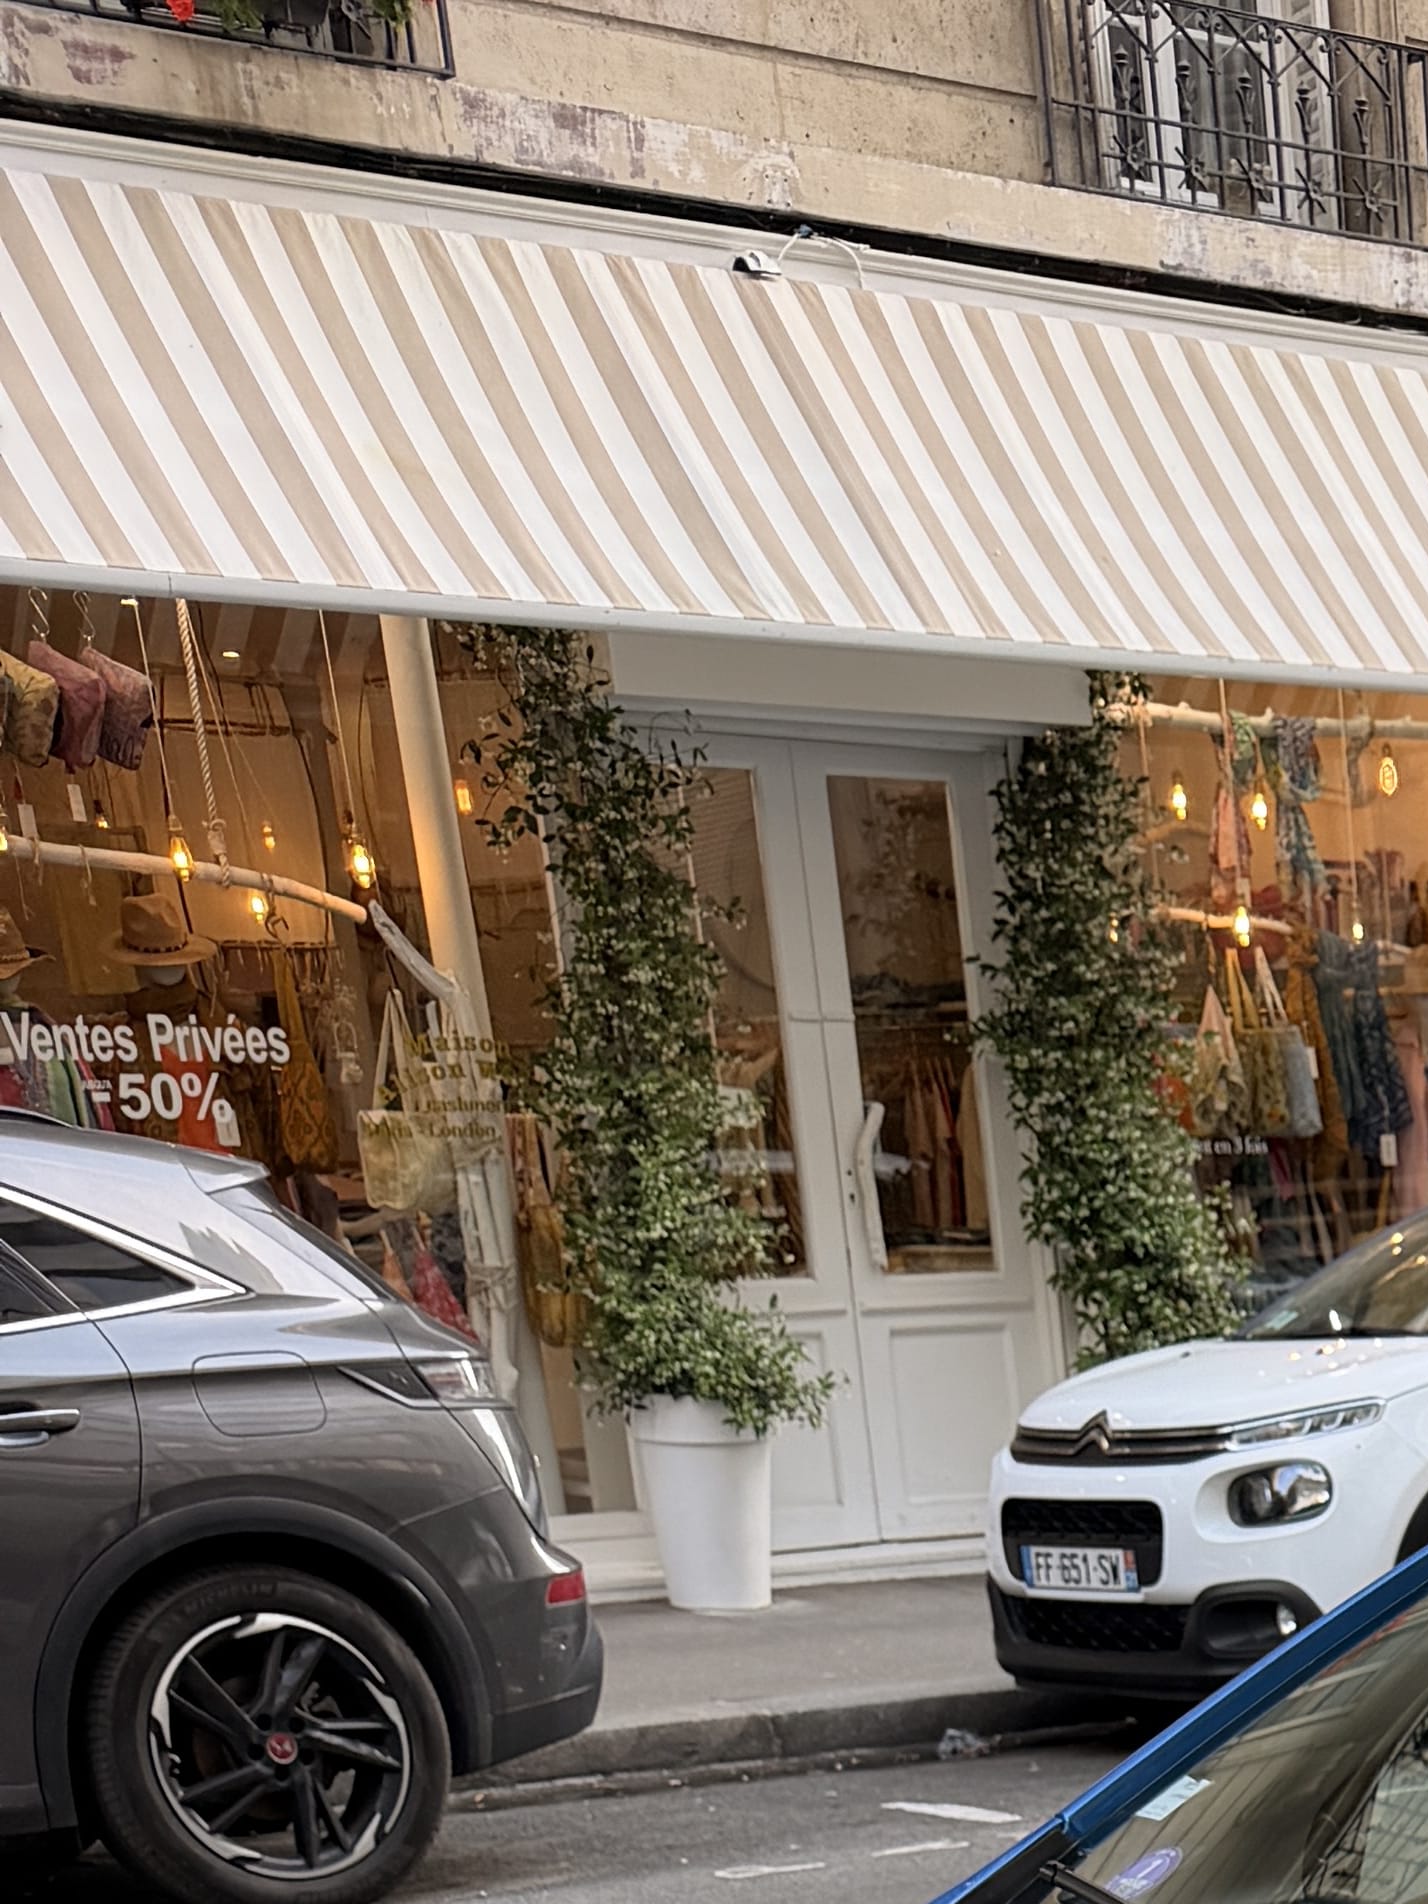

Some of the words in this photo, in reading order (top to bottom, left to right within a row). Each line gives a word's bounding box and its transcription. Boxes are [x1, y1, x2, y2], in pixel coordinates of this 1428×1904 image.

[0, 1010, 138, 1062] Ventes
[146, 1013, 291, 1064] Privées
[403, 1030, 510, 1058] Maison
[429, 1121, 496, 1138] London
